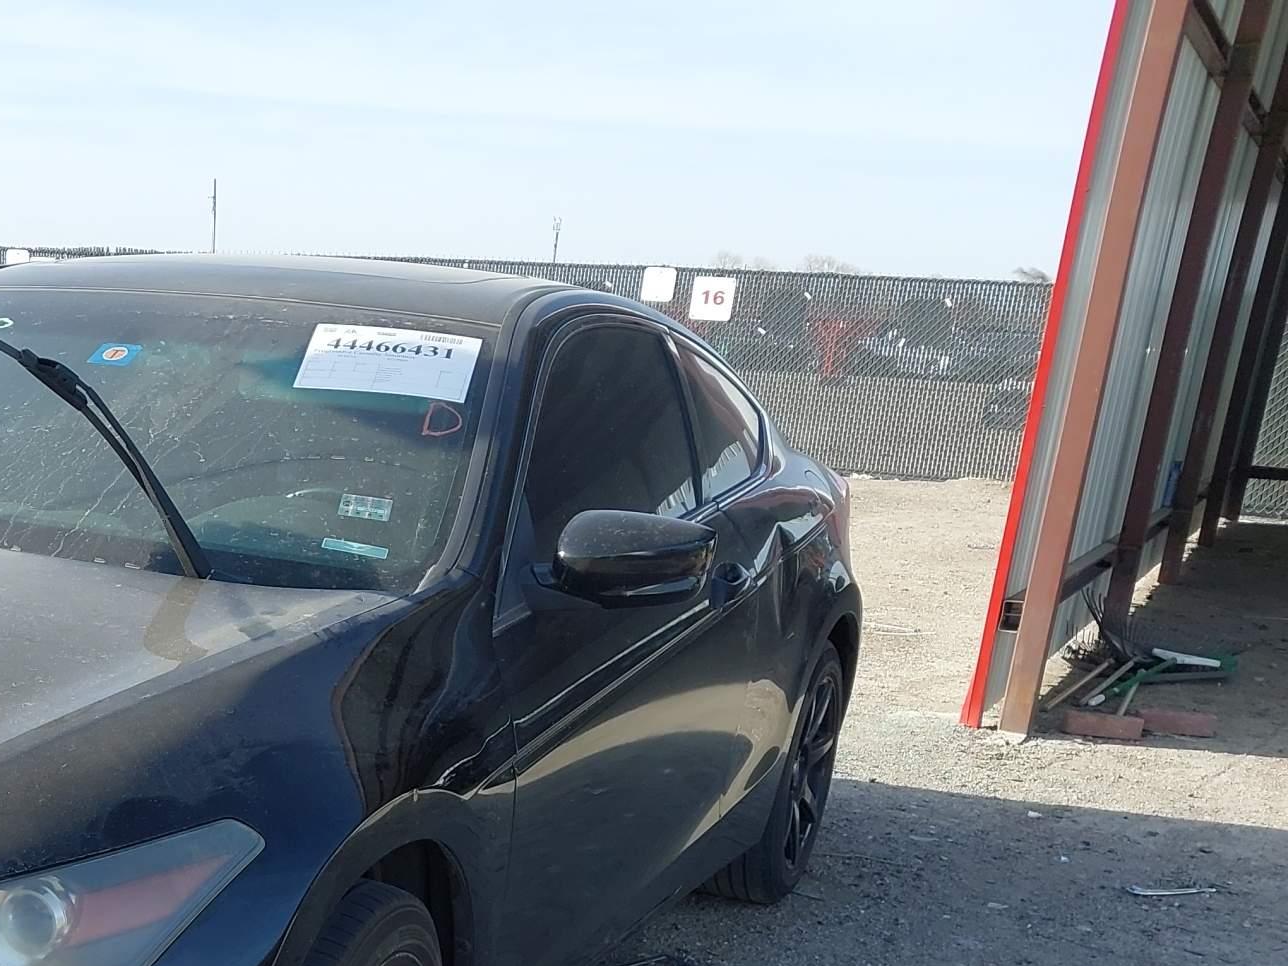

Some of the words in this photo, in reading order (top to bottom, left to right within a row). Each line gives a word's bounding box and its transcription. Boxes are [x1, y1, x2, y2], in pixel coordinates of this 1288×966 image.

[701, 289, 726, 306] 16
[327, 337, 454, 360] 44466431
[421, 401, 463, 437] D
